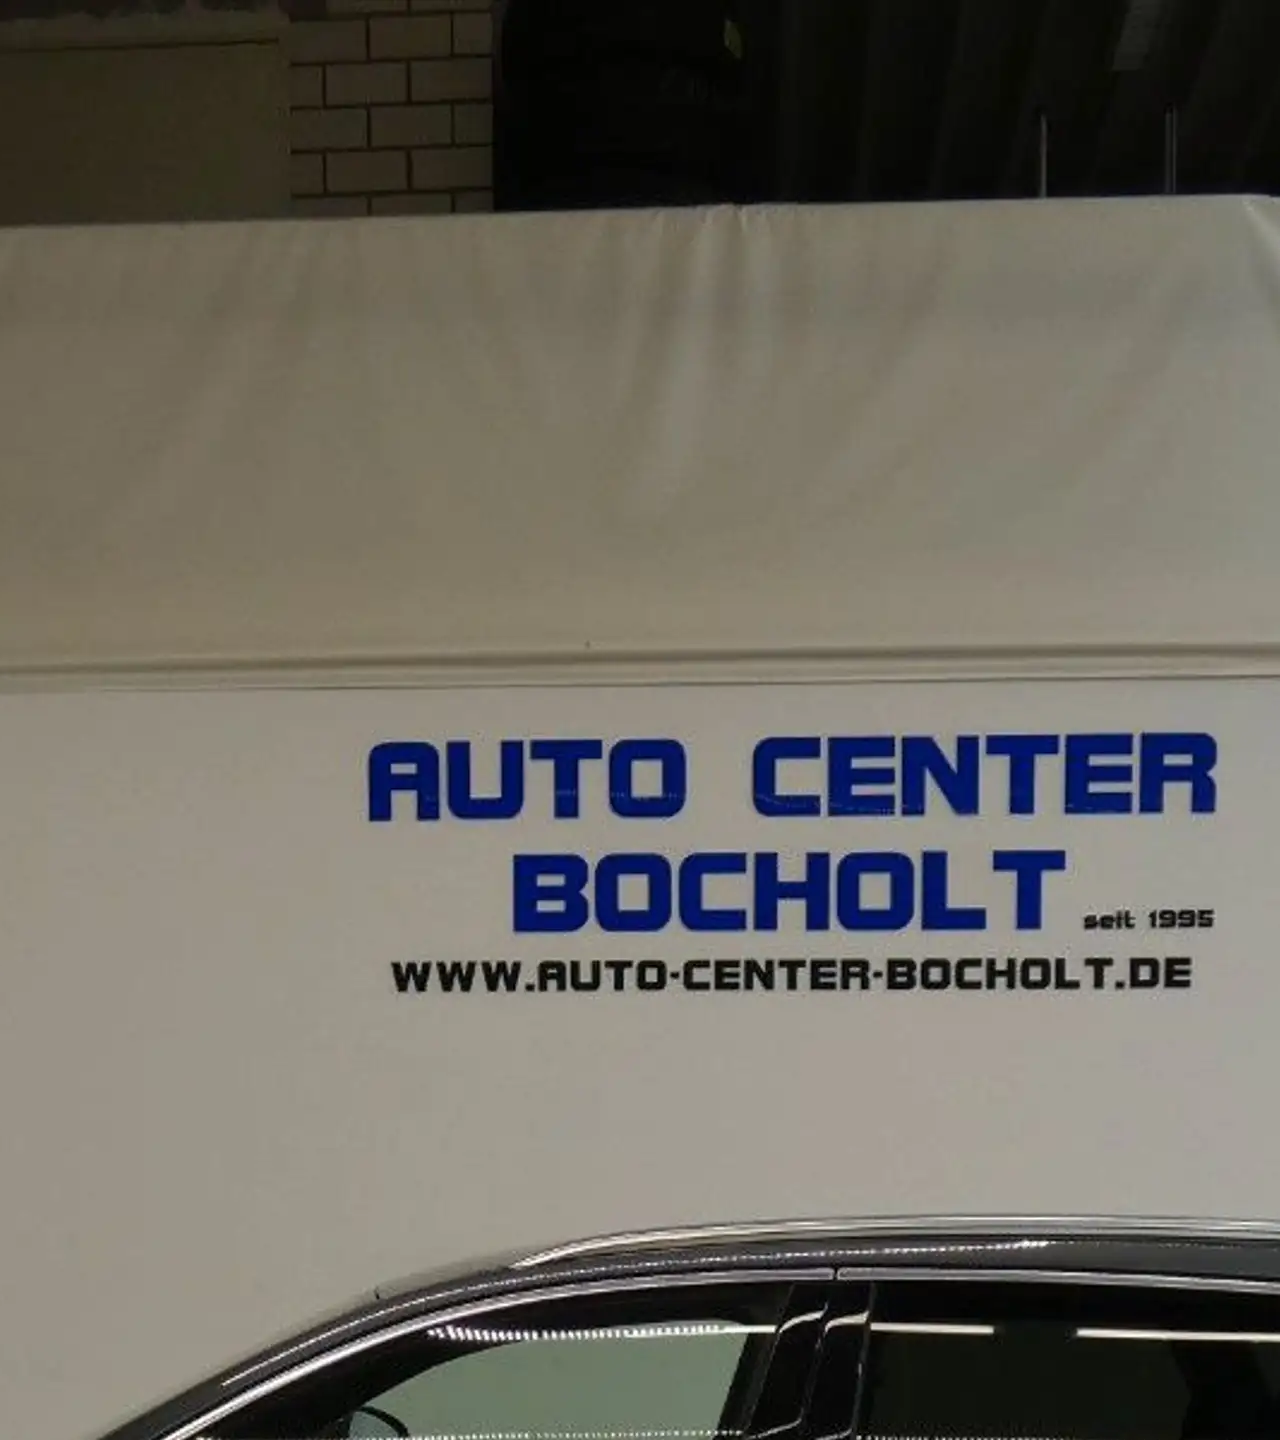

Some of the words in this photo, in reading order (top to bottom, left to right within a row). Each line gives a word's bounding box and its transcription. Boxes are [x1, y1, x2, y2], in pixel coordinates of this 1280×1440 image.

[367, 738, 687, 823] AUTO
[751, 731, 1218, 818] CENTER
[512, 849, 1067, 934] BOCHOLT
[1083, 909, 1136, 931] seit
[1148, 909, 1216, 930] 1995
[390, 956, 1192, 993] WWW.AUTO-CENTER-BOCHOLT.DE
